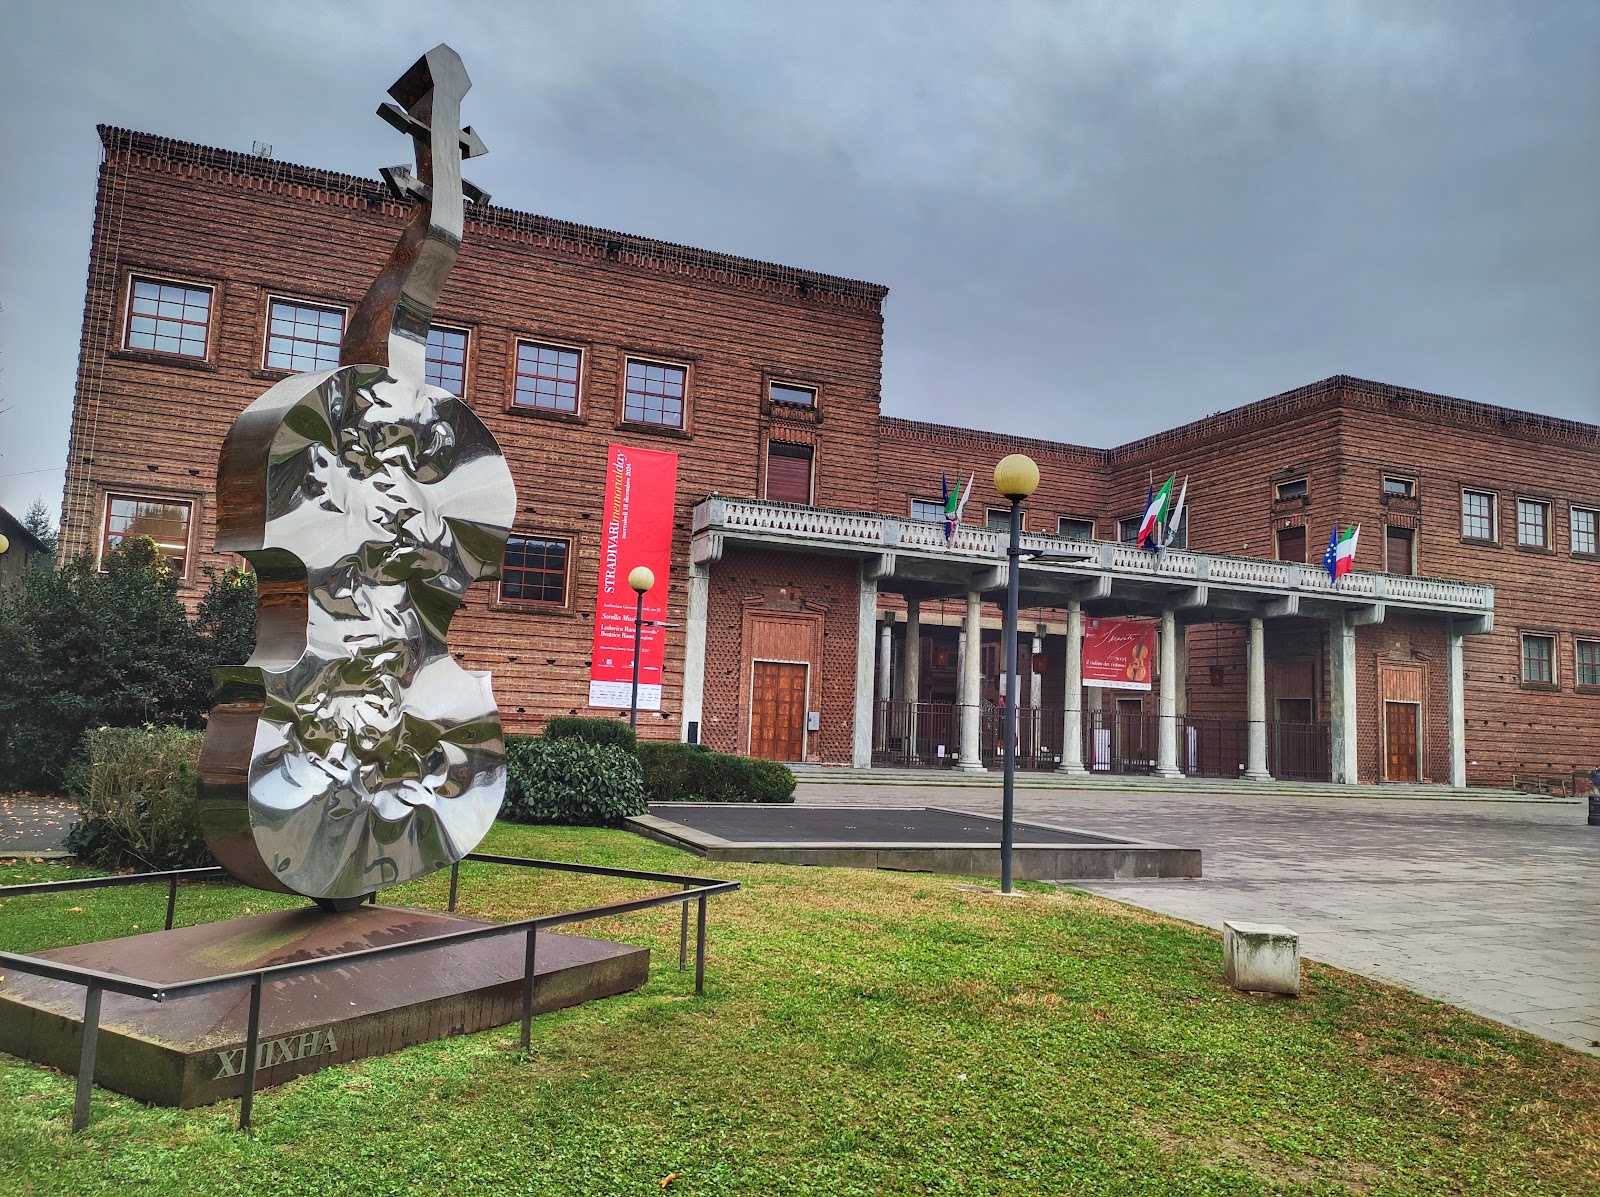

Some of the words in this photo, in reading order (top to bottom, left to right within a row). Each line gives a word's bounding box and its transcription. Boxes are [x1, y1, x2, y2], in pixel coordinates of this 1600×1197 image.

[622, 503, 629, 511] 18
[602, 613, 620, 621] Sorella
[601, 624, 623, 632] Ludovica
